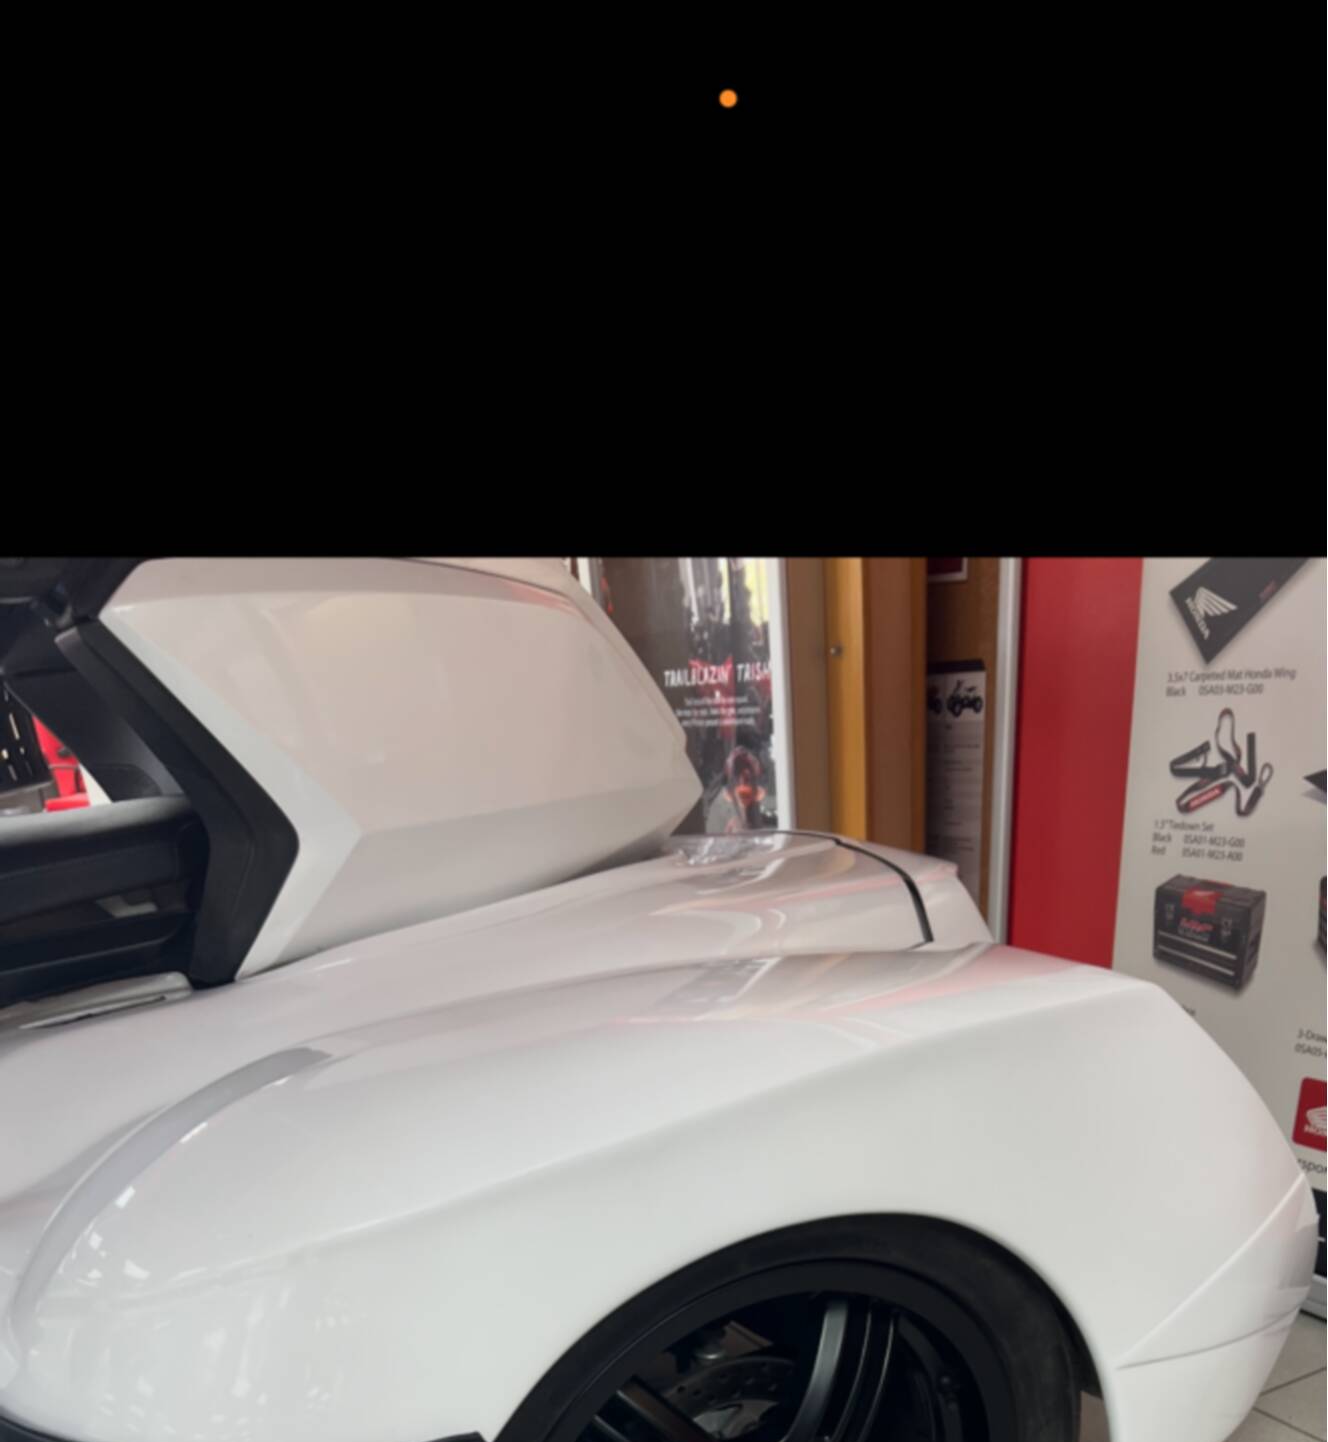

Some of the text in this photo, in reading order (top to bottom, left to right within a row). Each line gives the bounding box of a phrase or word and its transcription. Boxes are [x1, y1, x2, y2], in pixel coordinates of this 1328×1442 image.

[1189, 670, 1225, 684] Carpeted
[1245, 668, 1272, 680] Honda
[1274, 667, 1297, 681] Wing
[1166, 686, 1186, 697] Black
[1152, 833, 1172, 843] Black
[1151, 846, 1167, 855] Red
